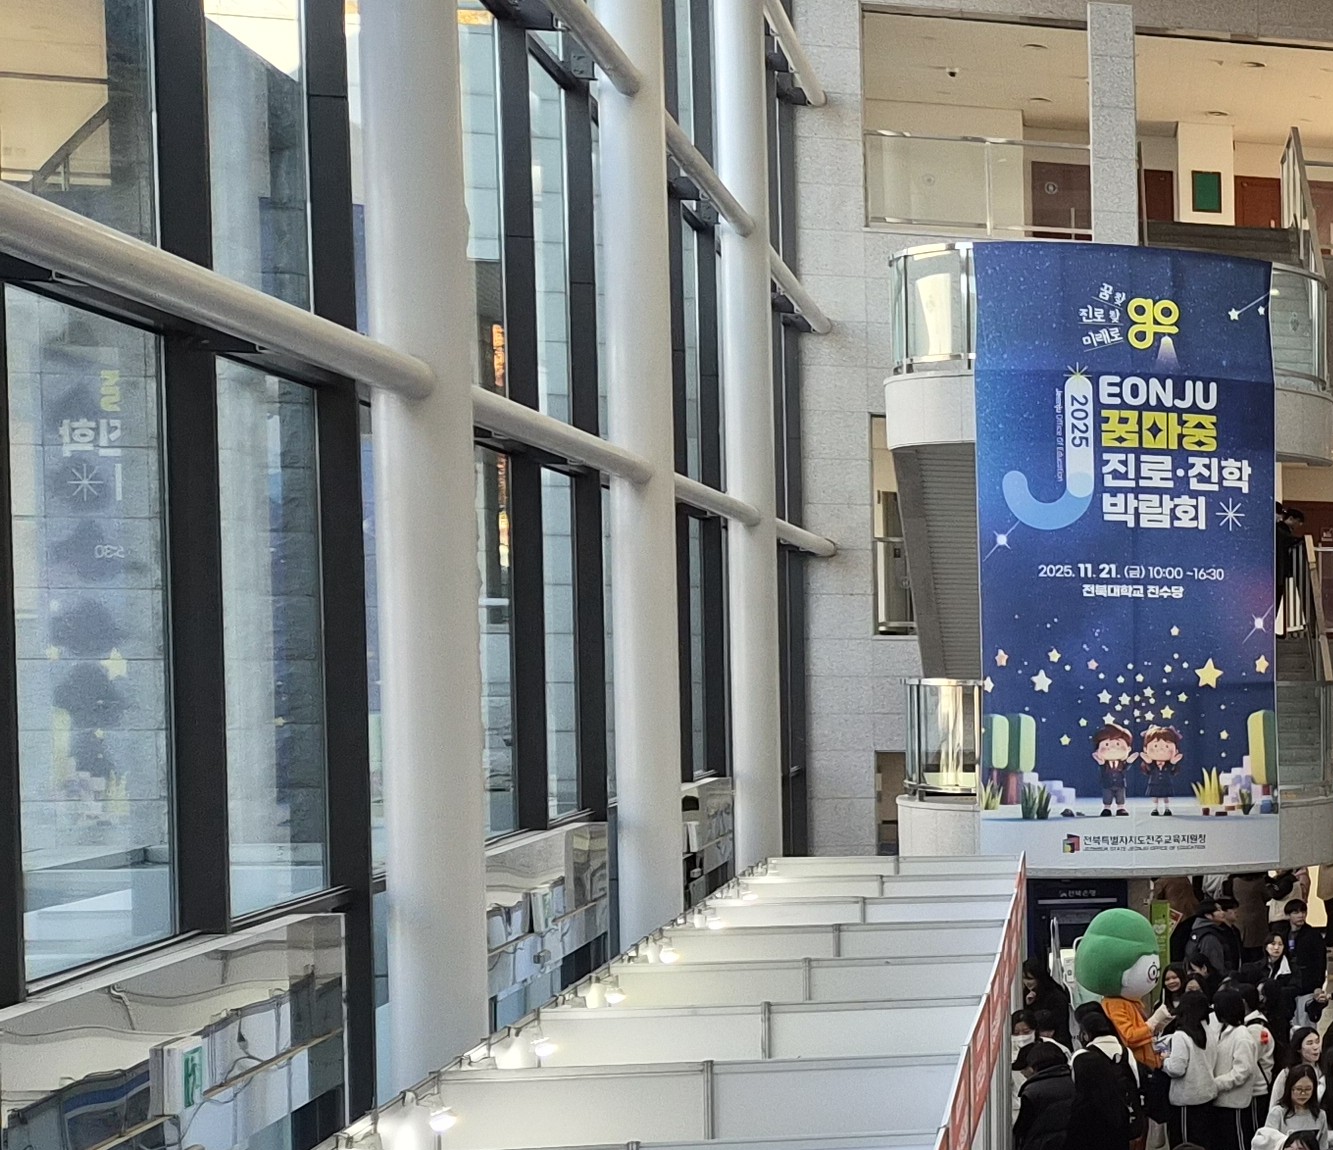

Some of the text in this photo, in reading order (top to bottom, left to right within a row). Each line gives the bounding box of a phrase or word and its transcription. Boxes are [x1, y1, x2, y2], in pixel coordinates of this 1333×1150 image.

[1098, 282, 1114, 301] 꿈
[1078, 304, 1106, 323] 진로
[1082, 326, 1124, 348] 미래로
[1070, 394, 1089, 448] 2025
[1101, 409, 1218, 452] 꿈마중
[1101, 452, 1252, 494] 진로·진학
[1101, 492, 1207, 530] 박람회
[1038, 564, 1076, 578] 2025.
[1077, 563, 1096, 578] 11.
[1098, 563, 1121, 578] 21.
[1123, 565, 1146, 579] (금)
[1148, 566, 1184, 579] 10:00
[1081, 583, 1185, 599] 전북대학교 진수당
